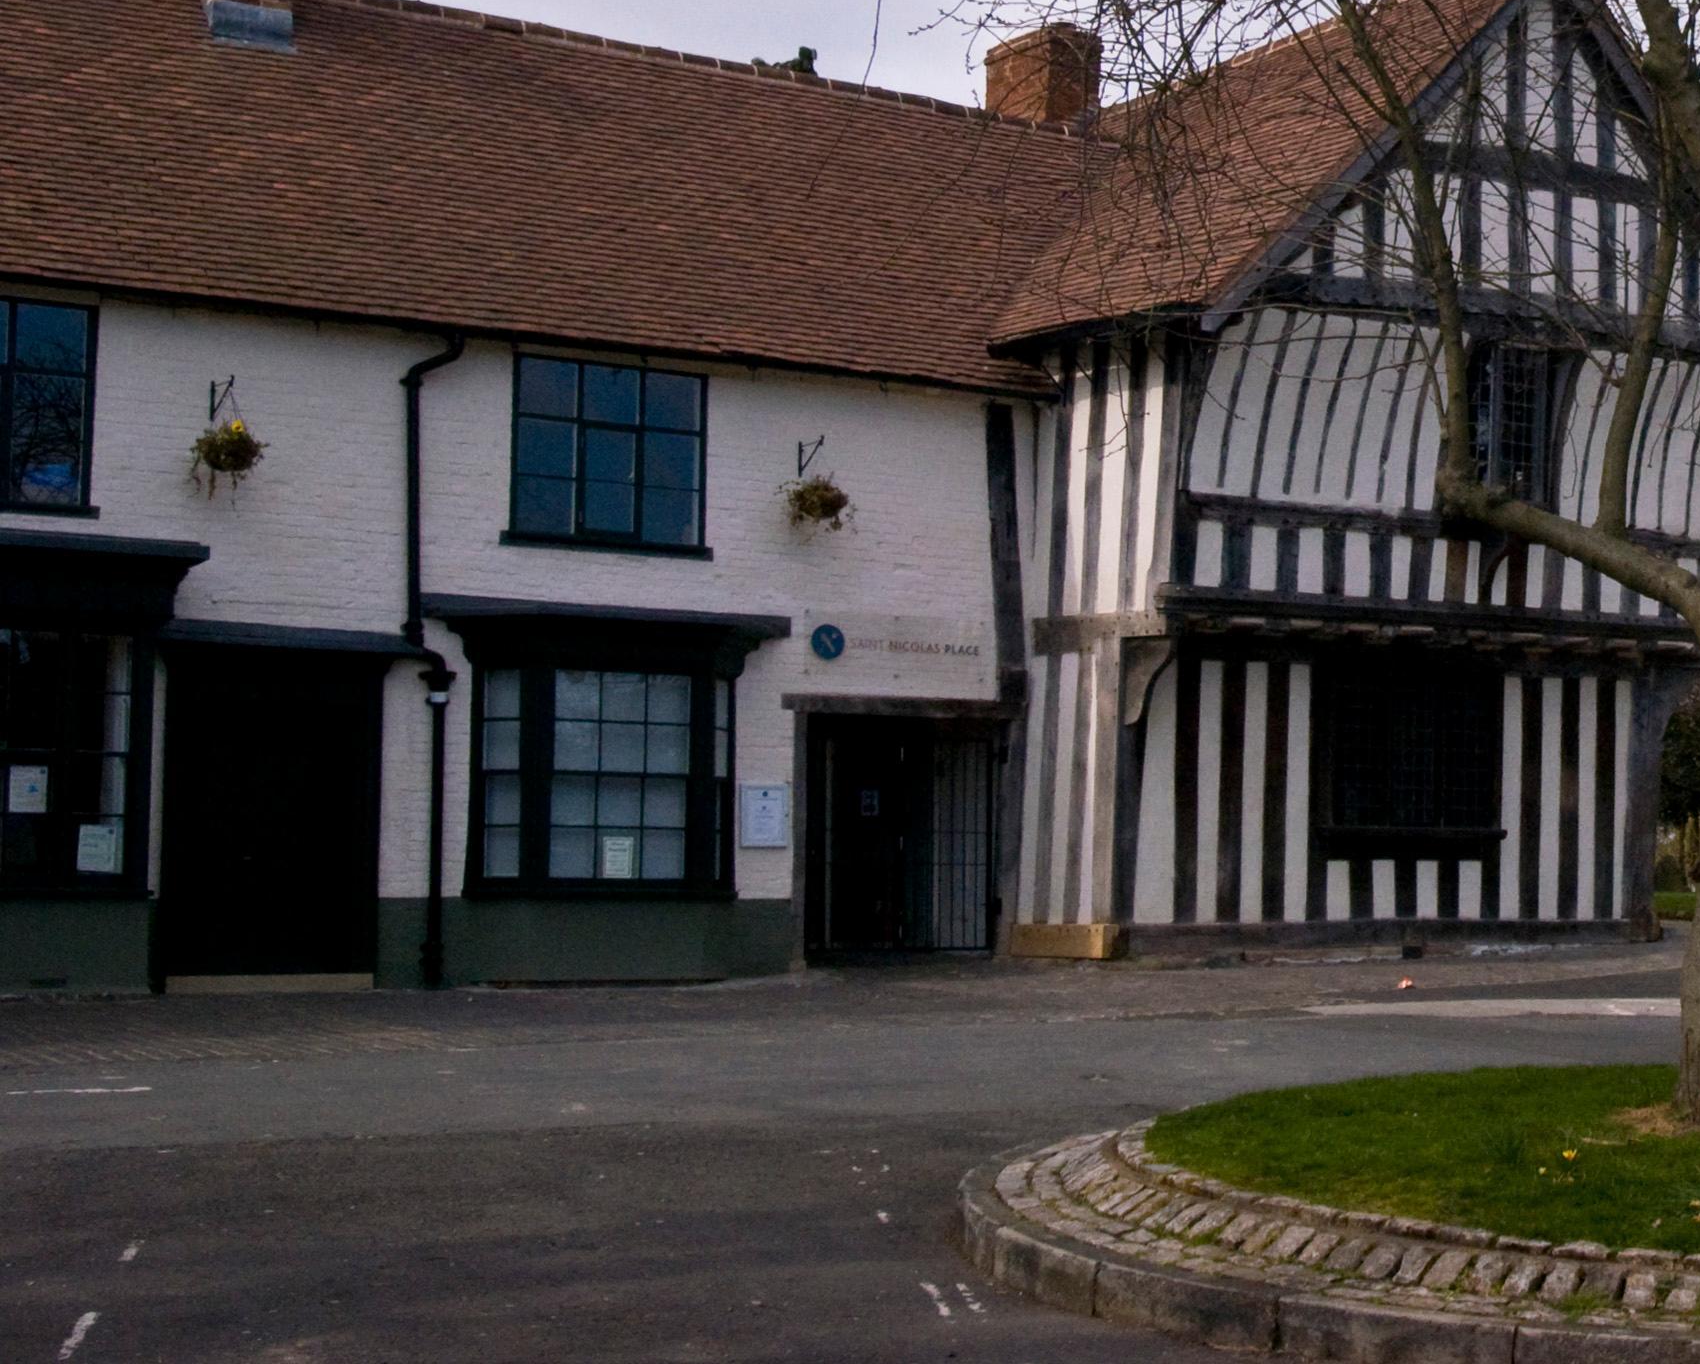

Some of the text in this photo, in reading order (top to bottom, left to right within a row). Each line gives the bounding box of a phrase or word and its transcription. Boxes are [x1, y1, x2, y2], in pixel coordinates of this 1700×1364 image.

[849, 639, 980, 657] SAINT NICOLAS PLACE
